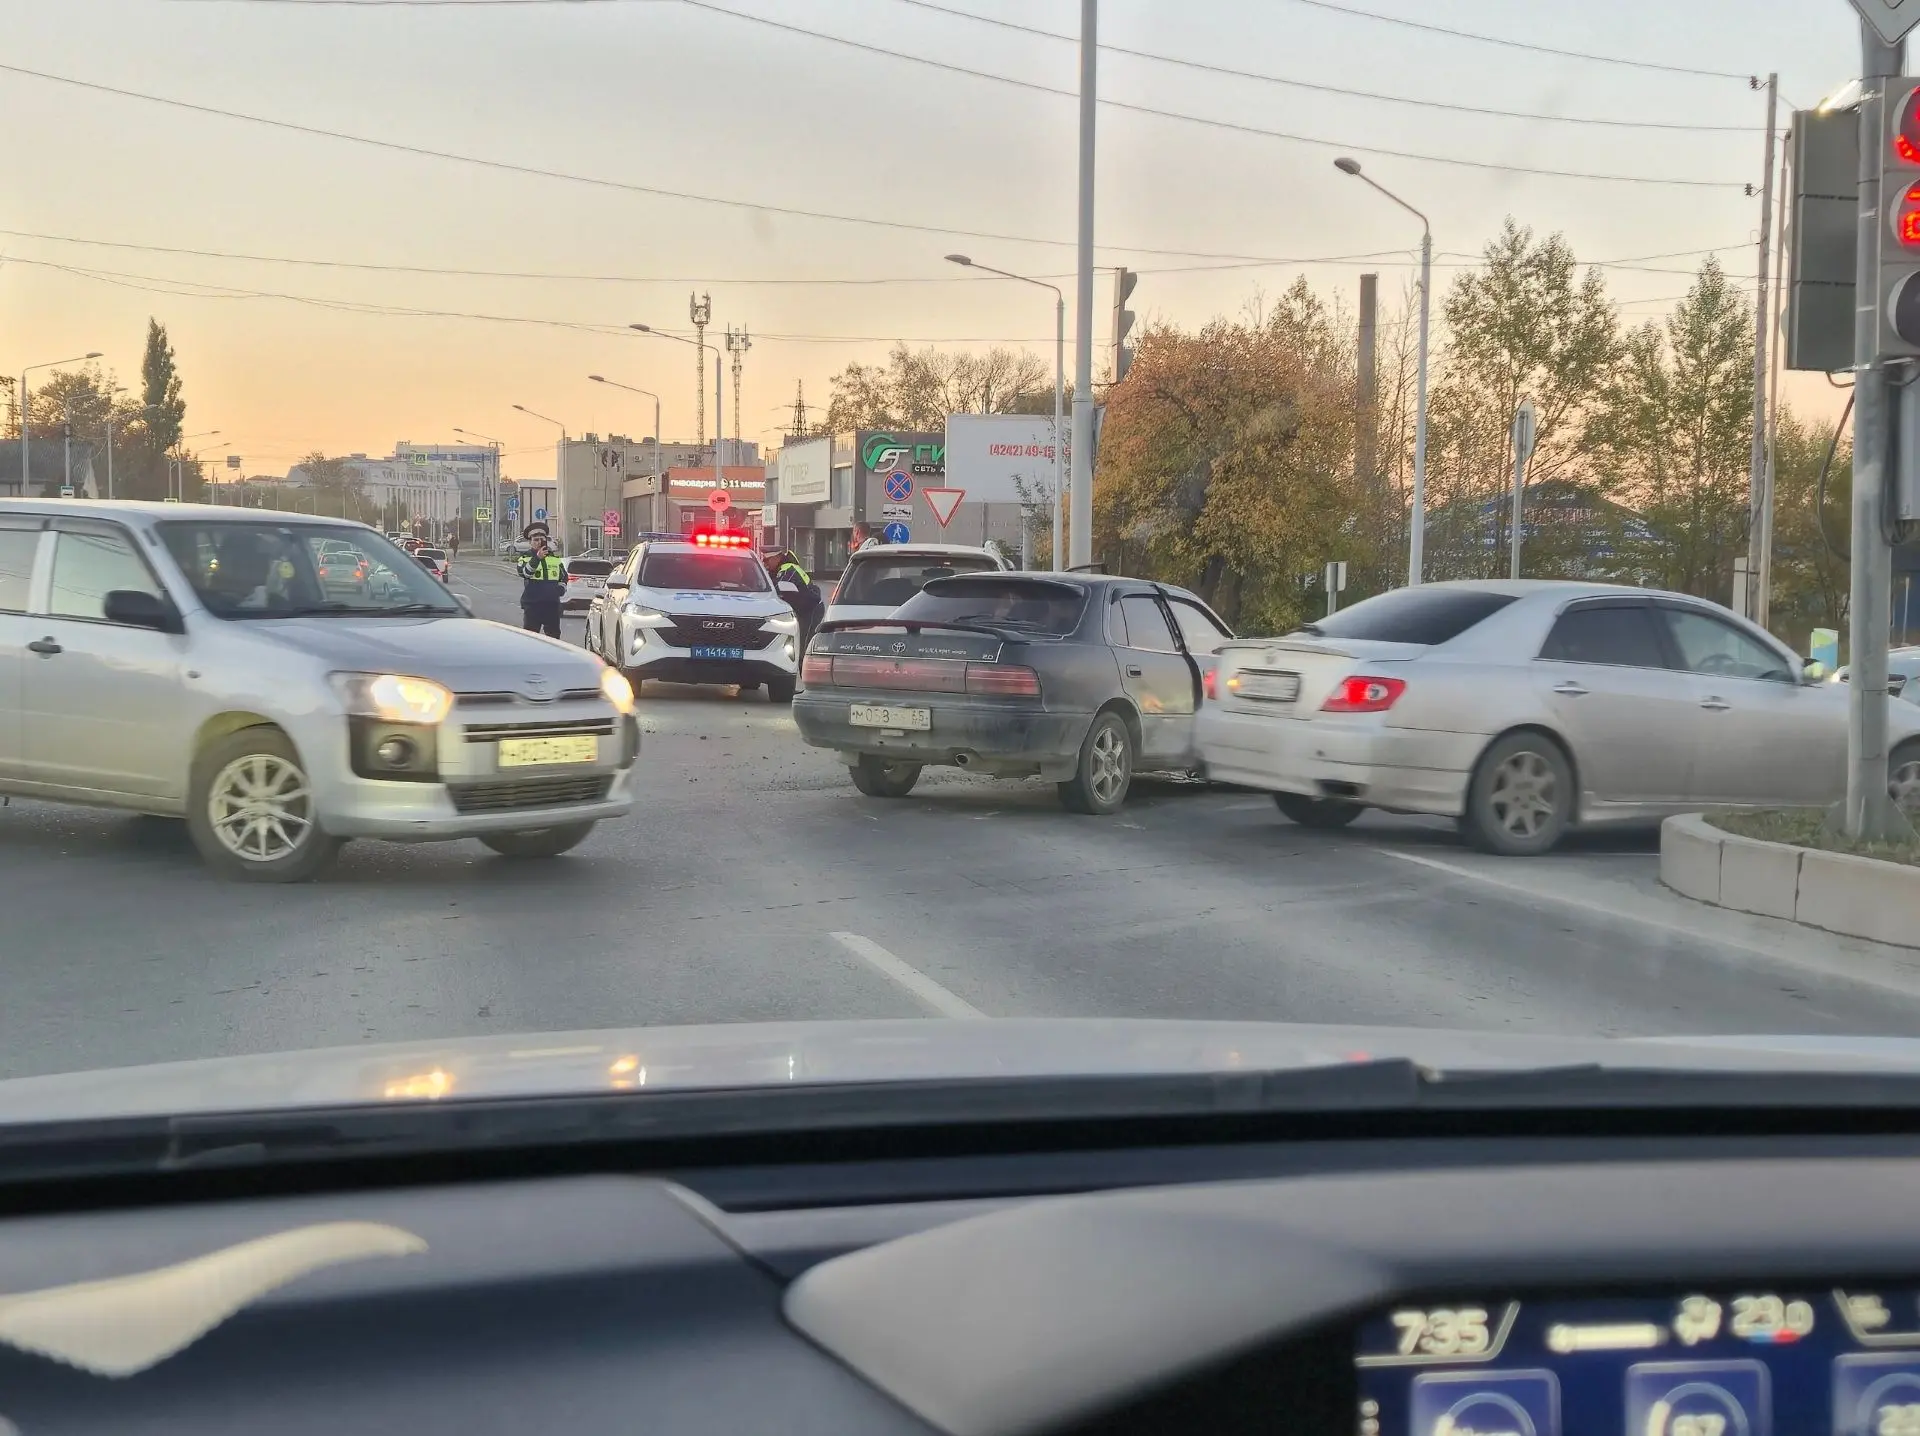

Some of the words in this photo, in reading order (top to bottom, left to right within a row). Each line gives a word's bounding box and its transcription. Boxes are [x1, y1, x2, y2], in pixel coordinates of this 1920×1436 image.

[914, 465, 936, 473] СЕТЬ
[706, 648, 727, 657] 1414
[731, 648, 741, 656] 65
